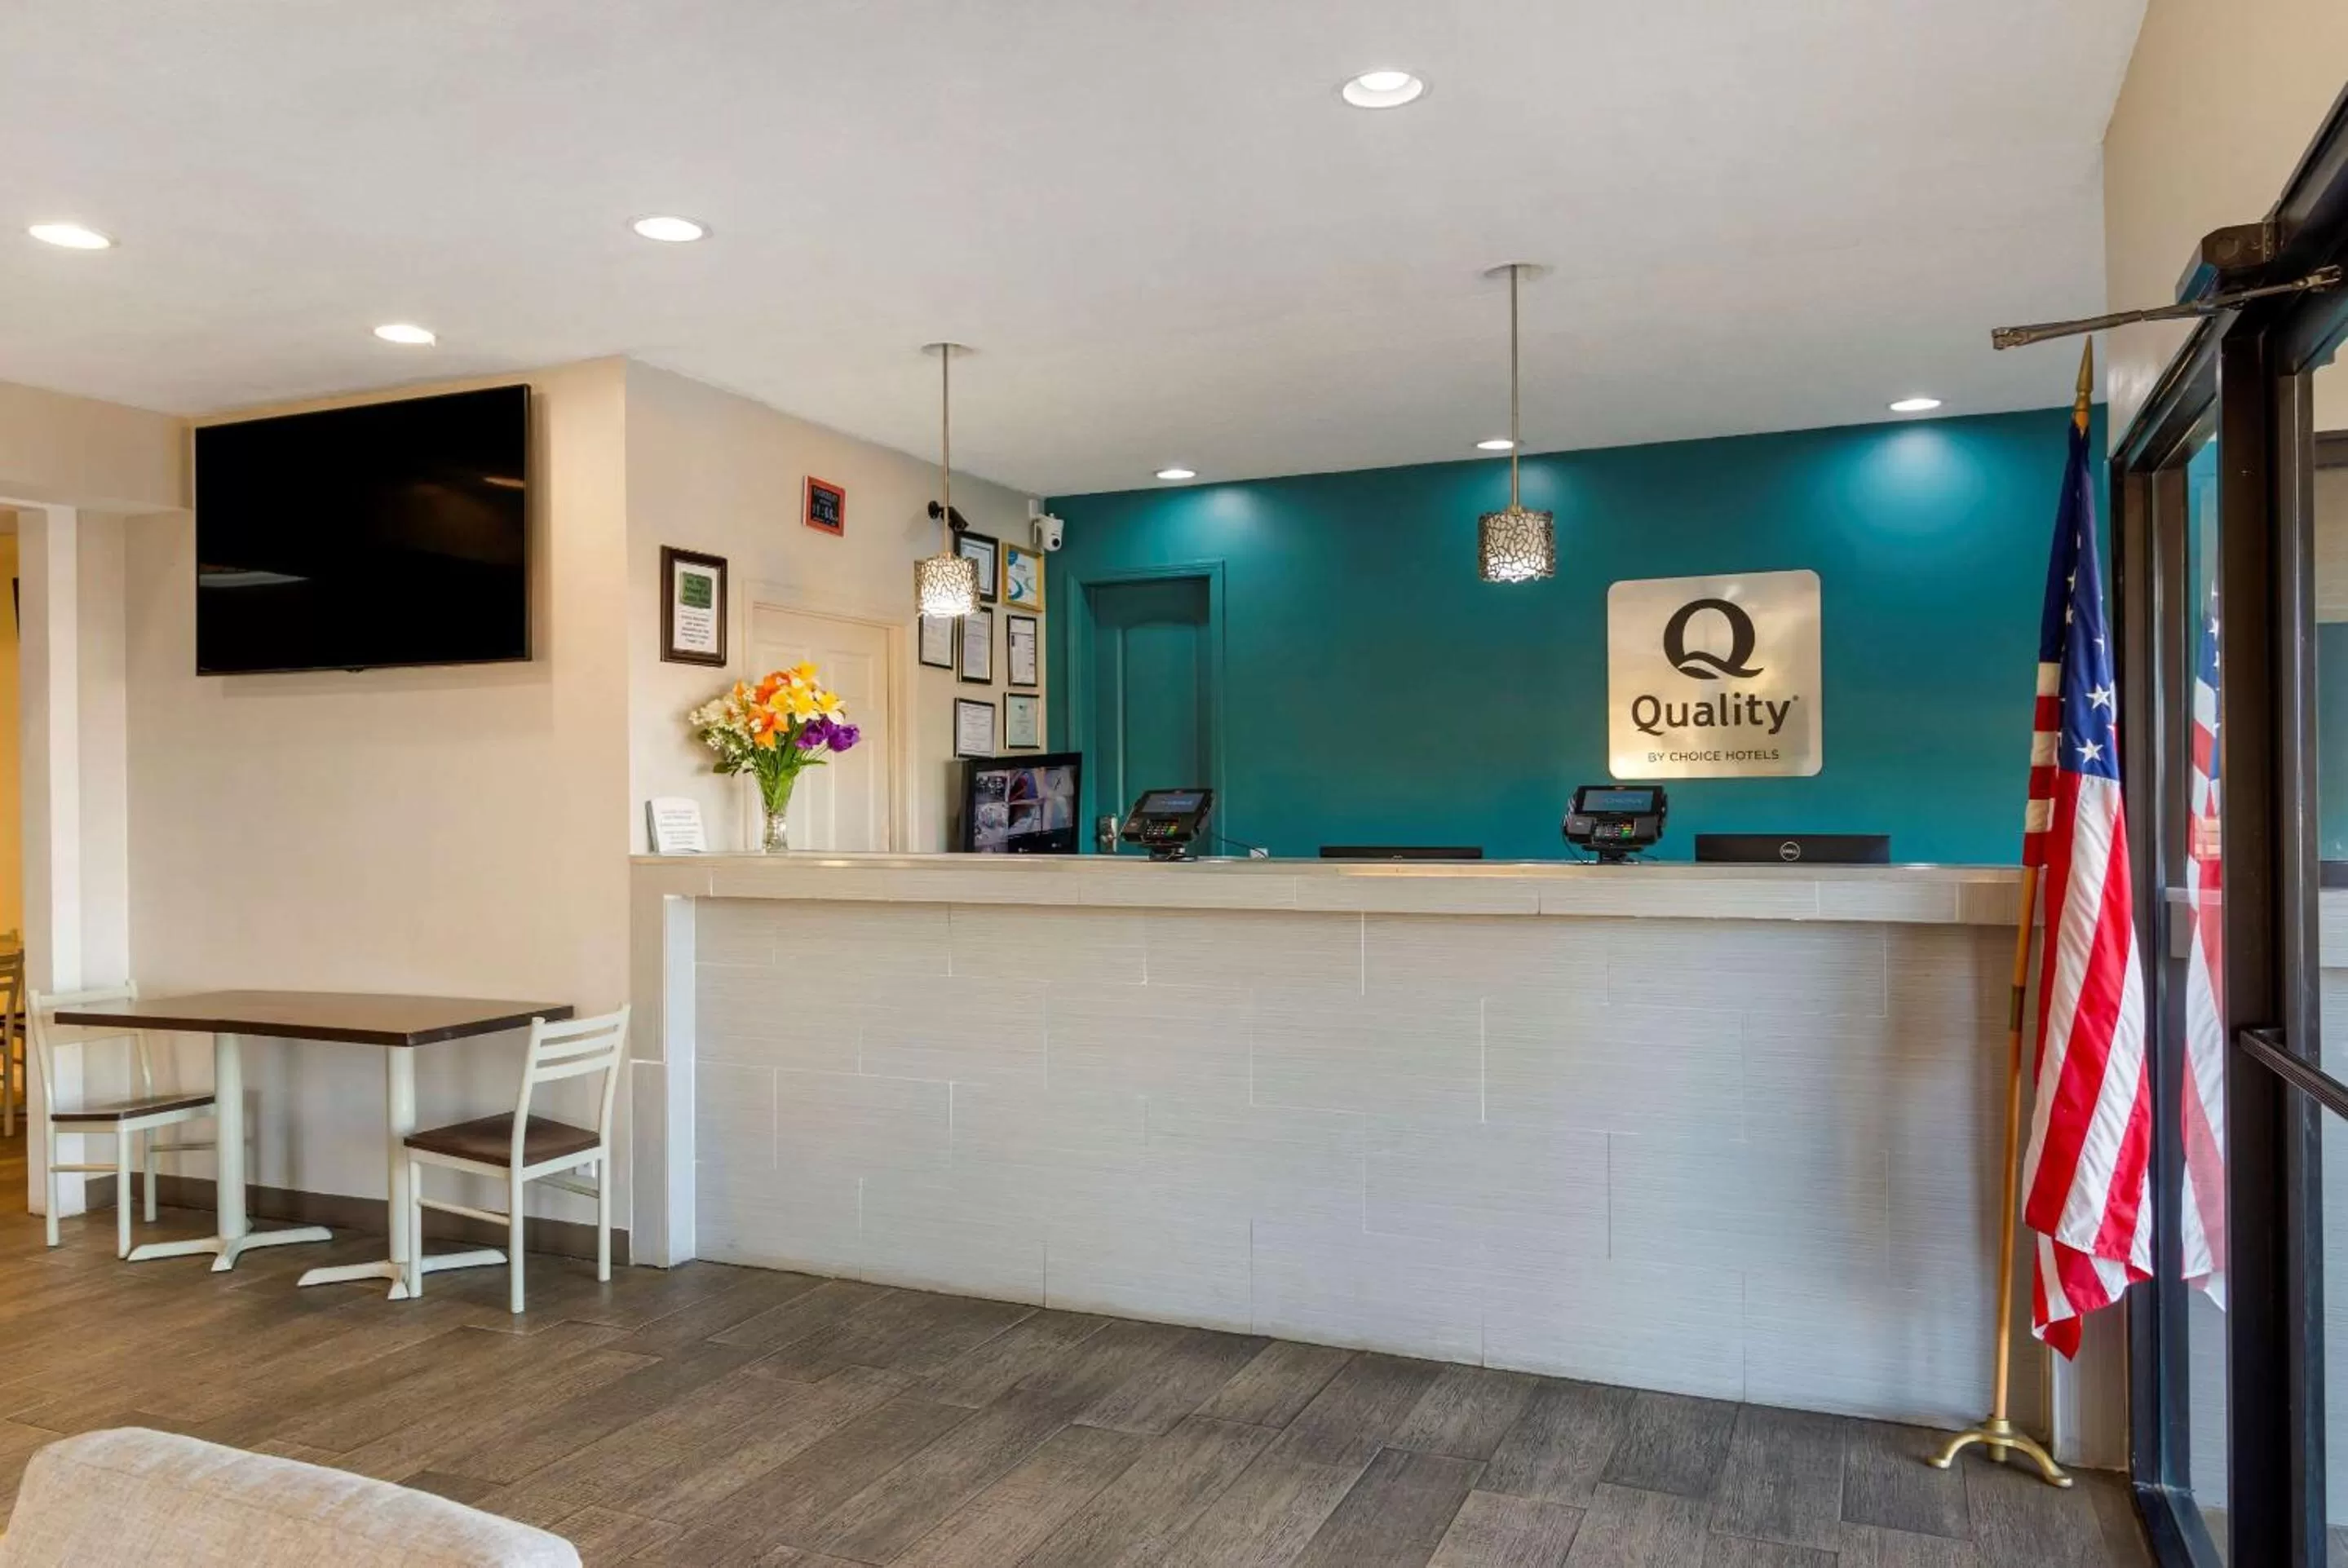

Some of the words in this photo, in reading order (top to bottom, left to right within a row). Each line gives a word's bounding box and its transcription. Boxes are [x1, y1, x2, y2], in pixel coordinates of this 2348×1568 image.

[1664, 598, 1764, 679] Q
[1632, 692, 1791, 735] Quality
[1647, 752, 1665, 762] BY
[1669, 750, 1721, 762] CHOICE
[1726, 749, 1780, 761] HOTELS
